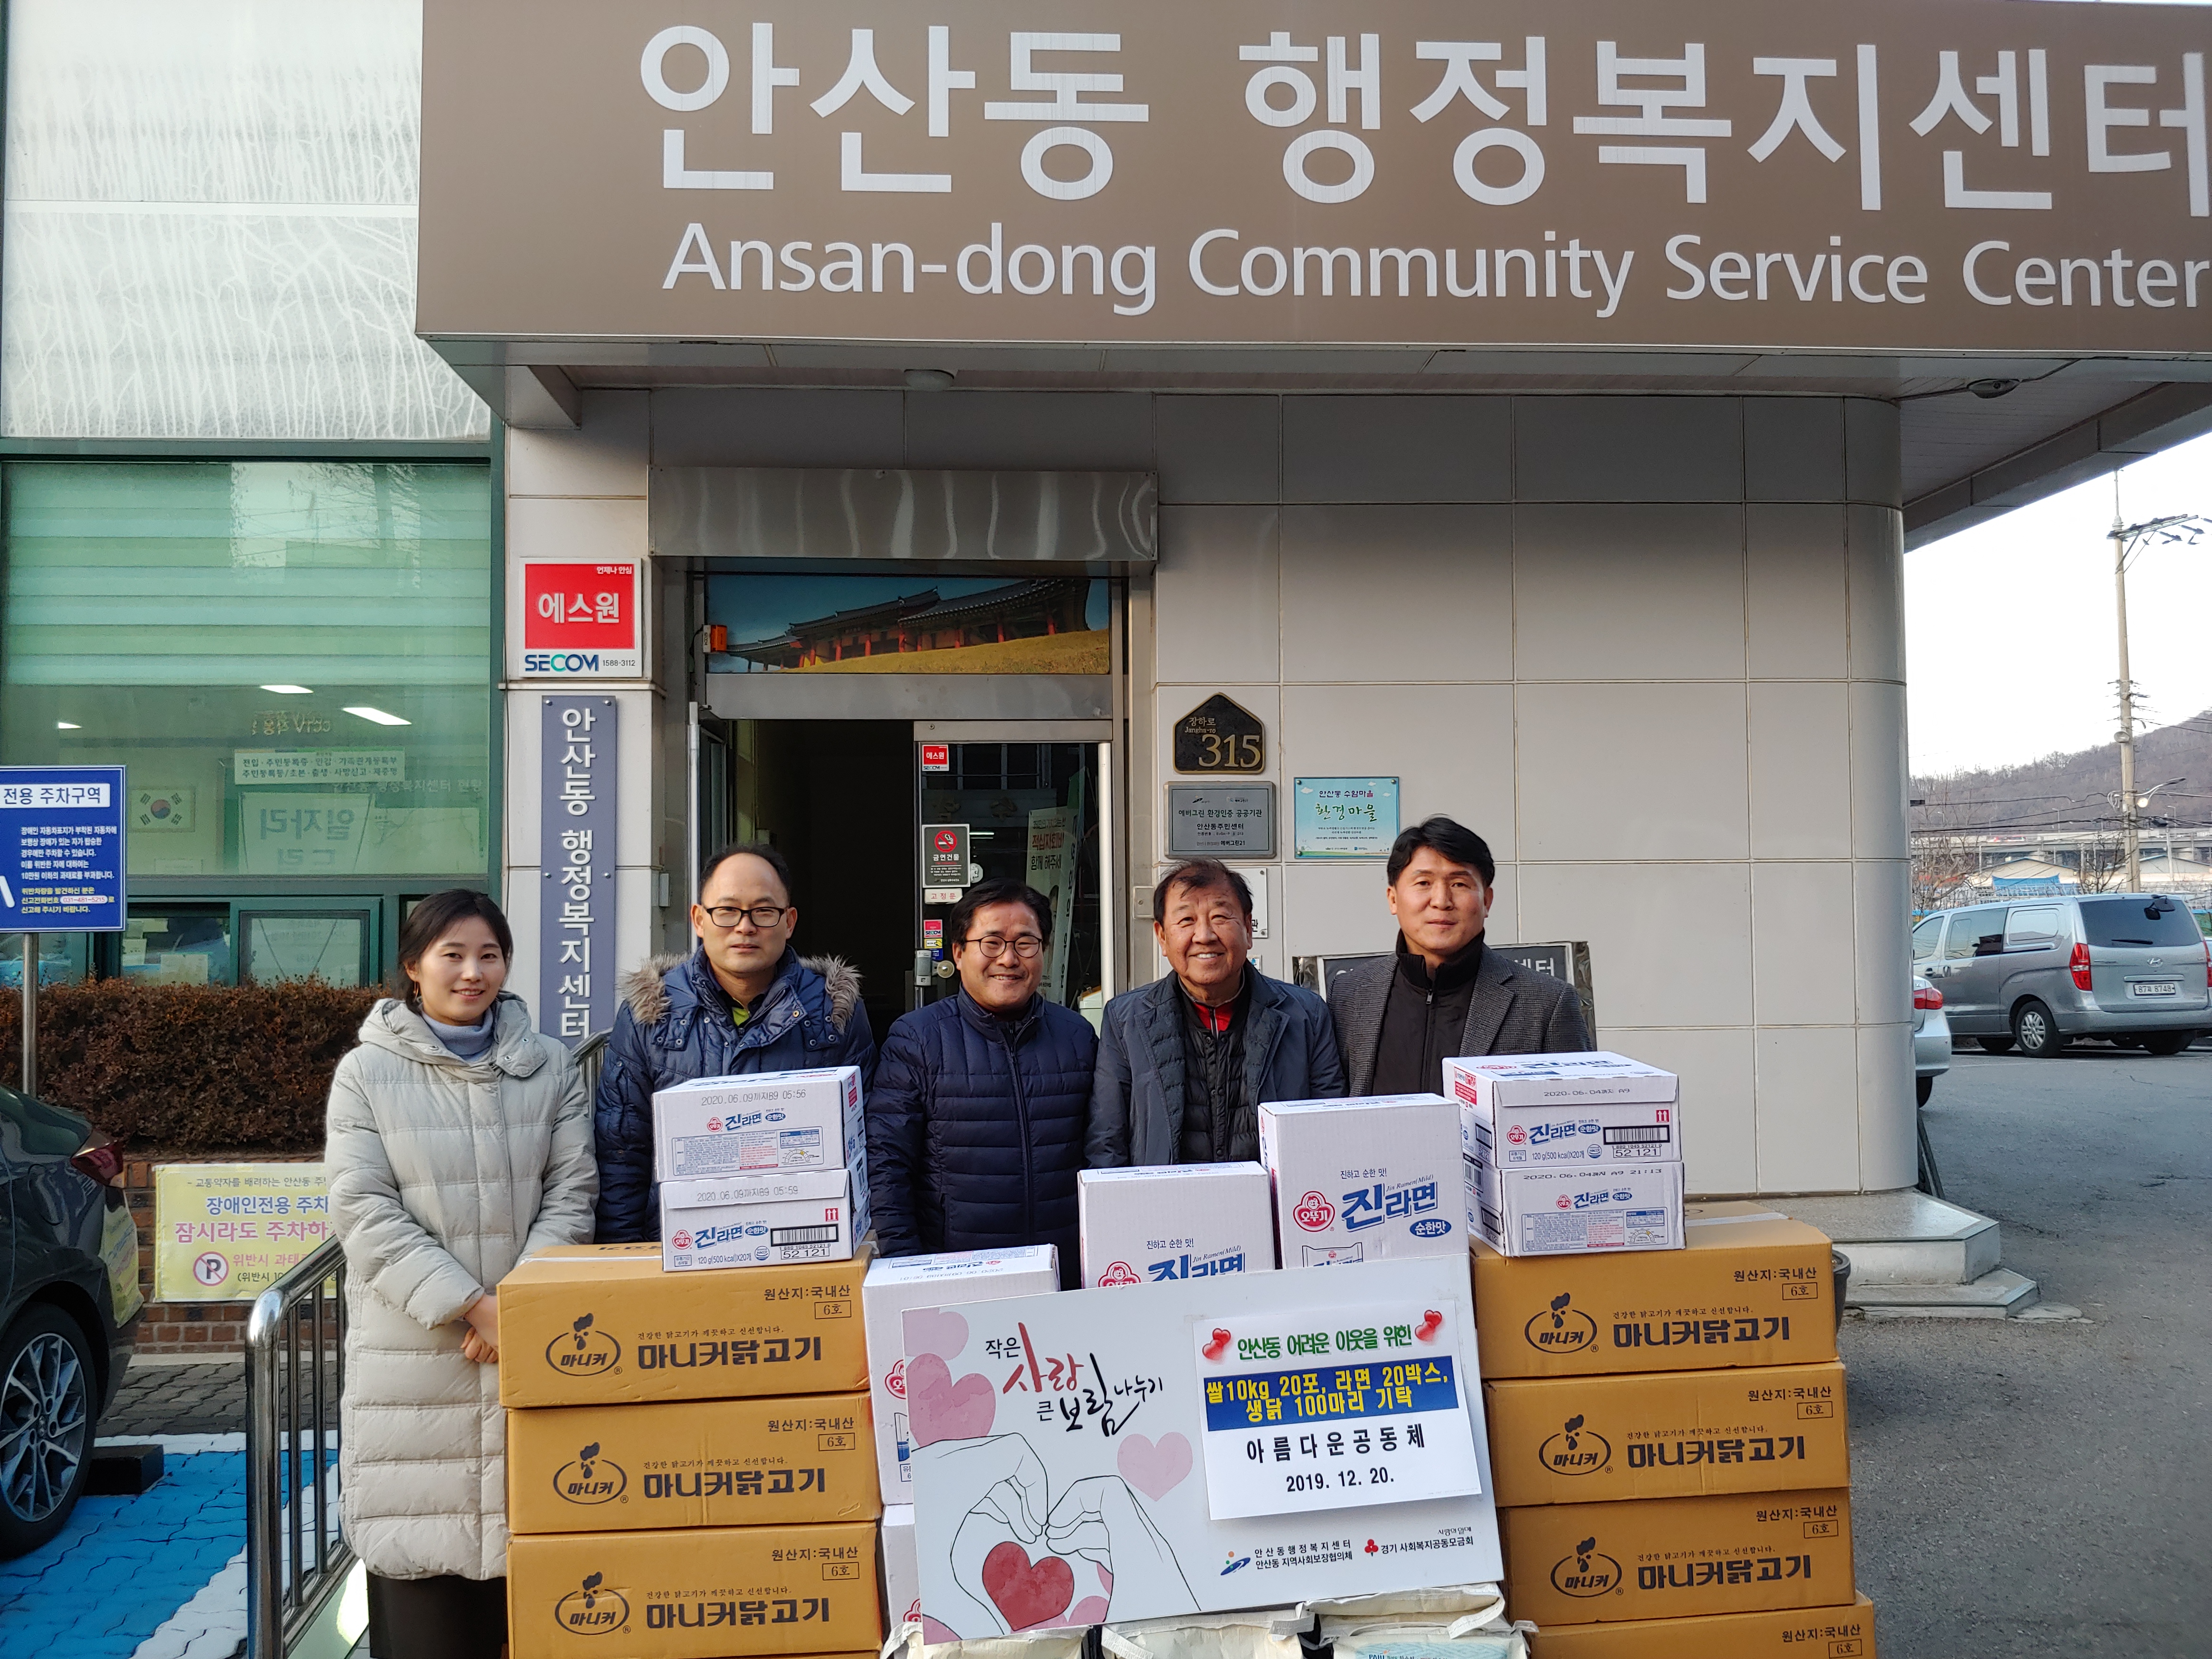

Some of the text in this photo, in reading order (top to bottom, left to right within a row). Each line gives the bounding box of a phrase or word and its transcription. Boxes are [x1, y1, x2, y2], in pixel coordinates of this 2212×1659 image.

[640, 22, 2210, 218] 안산동 행정복지센터
[661, 222, 2210, 319] Ansan-dong Community Service Center
[597, 566, 632, 575] 언제나 안심
[538, 592, 620, 623] 에스원
[524, 654, 600, 672] SECOM
[1189, 716, 1216, 727] 장하로
[1198, 734, 1261, 768] 315
[3, 787, 101, 805] 전용 주차구역
[1319, 790, 1373, 798] 안산동 수암마을
[1178, 809, 1262, 818] 에버그린 환경인증 공공기관
[1315, 803, 1377, 822] 환경마을
[21, 826, 39, 835] 장애인
[94, 826, 117, 835] 자동차에
[58, 838, 70, 846] 있는
[72, 838, 83, 846] 자가
[64, 849, 70, 858] 수
[72, 849, 96, 858] 있습니다.
[53, 860, 65, 868] 자에
[41, 872, 58, 880] 이하의
[559, 708, 596, 1039] 안산동 행정복지센터
[782, 1089, 807, 1099] 05:56
[725, 1112, 762, 1131] 진라면
[1580, 1125, 1600, 1133] 순한맛
[1529, 1123, 1576, 1145] 진라면
[1532, 1152, 1557, 1161] 120 g(500
[1340, 1167, 1387, 1180] 진하고 순한 맛!
[195, 1176, 311, 1188] 교통약자를 배려하는 안산동
[1385, 1173, 1434, 1193] Jin Ramen(Mild)
[774, 1185, 799, 1196] 05:59
[206, 1196, 291, 1215] 장애인전용
[1341, 1182, 1438, 1232] 진라면
[1573, 1192, 1610, 1209] 진라면
[1299, 1210, 1328, 1224] 오뚜기
[175, 1220, 336, 1243] 잠시라도 주차하
[747, 1227, 767, 1235] 순한맛
[1414, 1220, 1447, 1237] 순한맛
[695, 1224, 744, 1250] 진라면
[1146, 1238, 1194, 1249] 진하고 순한 맛!
[233, 1254, 269, 1267] 위반시
[697, 1255, 723, 1265] 120 g(500
[782, 1250, 800, 1259] 52
[1192, 1244, 1241, 1263] Jin Ramen(Mild)
[237, 1272, 269, 1282] (위반시
[1734, 1267, 1817, 1282] 원산지:국내산
[764, 1284, 851, 1302] 원산지:국내산
[1790, 1284, 1809, 1297] 6호
[823, 1303, 842, 1316] 6호
[638, 1326, 784, 1340] 건강한 닭고기가 깨끗하고 신선합니다.
[1539, 1331, 1585, 1345] 마니커
[1613, 1316, 1790, 1348] 마니커닭고기
[1238, 1336, 1281, 1361] 안산동
[1287, 1333, 1330, 1356] 어려운
[1335, 1327, 1379, 1352] 이웃을
[560, 1352, 608, 1367] 마니커
[638, 1336, 822, 1370] 마니커닭고기
[985, 1322, 1084, 1394] 작은 사랑
[1206, 1361, 1448, 1404] 쌀10kg 20포, 라면 20박스,
[1747, 1387, 1831, 1402] 원산지:국내산
[1246, 1385, 1412, 1422] 생닭 100마리 기탁
[1806, 1404, 1824, 1416] 6호
[1036, 1402, 1054, 1421] 큰
[767, 1418, 854, 1433] 원산지:국내산
[826, 1435, 847, 1448] 6호
[1247, 1423, 1424, 1464] 아름다운공동체
[1553, 1452, 1598, 1467] 마니커
[1627, 1436, 1805, 1468] 마니커닭고기
[644, 1468, 826, 1499] 마니커닭고기
[1286, 1467, 1394, 1492] 2019. 12. 20.
[567, 1481, 614, 1496] 마니커
[1756, 1505, 1837, 1522] 원산지:국내산
[1812, 1524, 1830, 1535] 6호
[1381, 1536, 1474, 1555] 경기 사회복지공동모금회
[772, 1546, 858, 1562] 원산지:국내산
[1255, 1550, 1353, 1571] 안산동 지역사회보장협의체
[830, 1565, 850, 1578] 6호
[1637, 1555, 1812, 1590] 마니커닭고기
[1564, 1574, 1609, 1589] 마니커
[569, 1611, 616, 1626] 마니커
[646, 1597, 830, 1629] 마니커닭고기
[1782, 1624, 1861, 1642] 원산지:국내산
[1837, 1642, 1855, 1655] 6호
